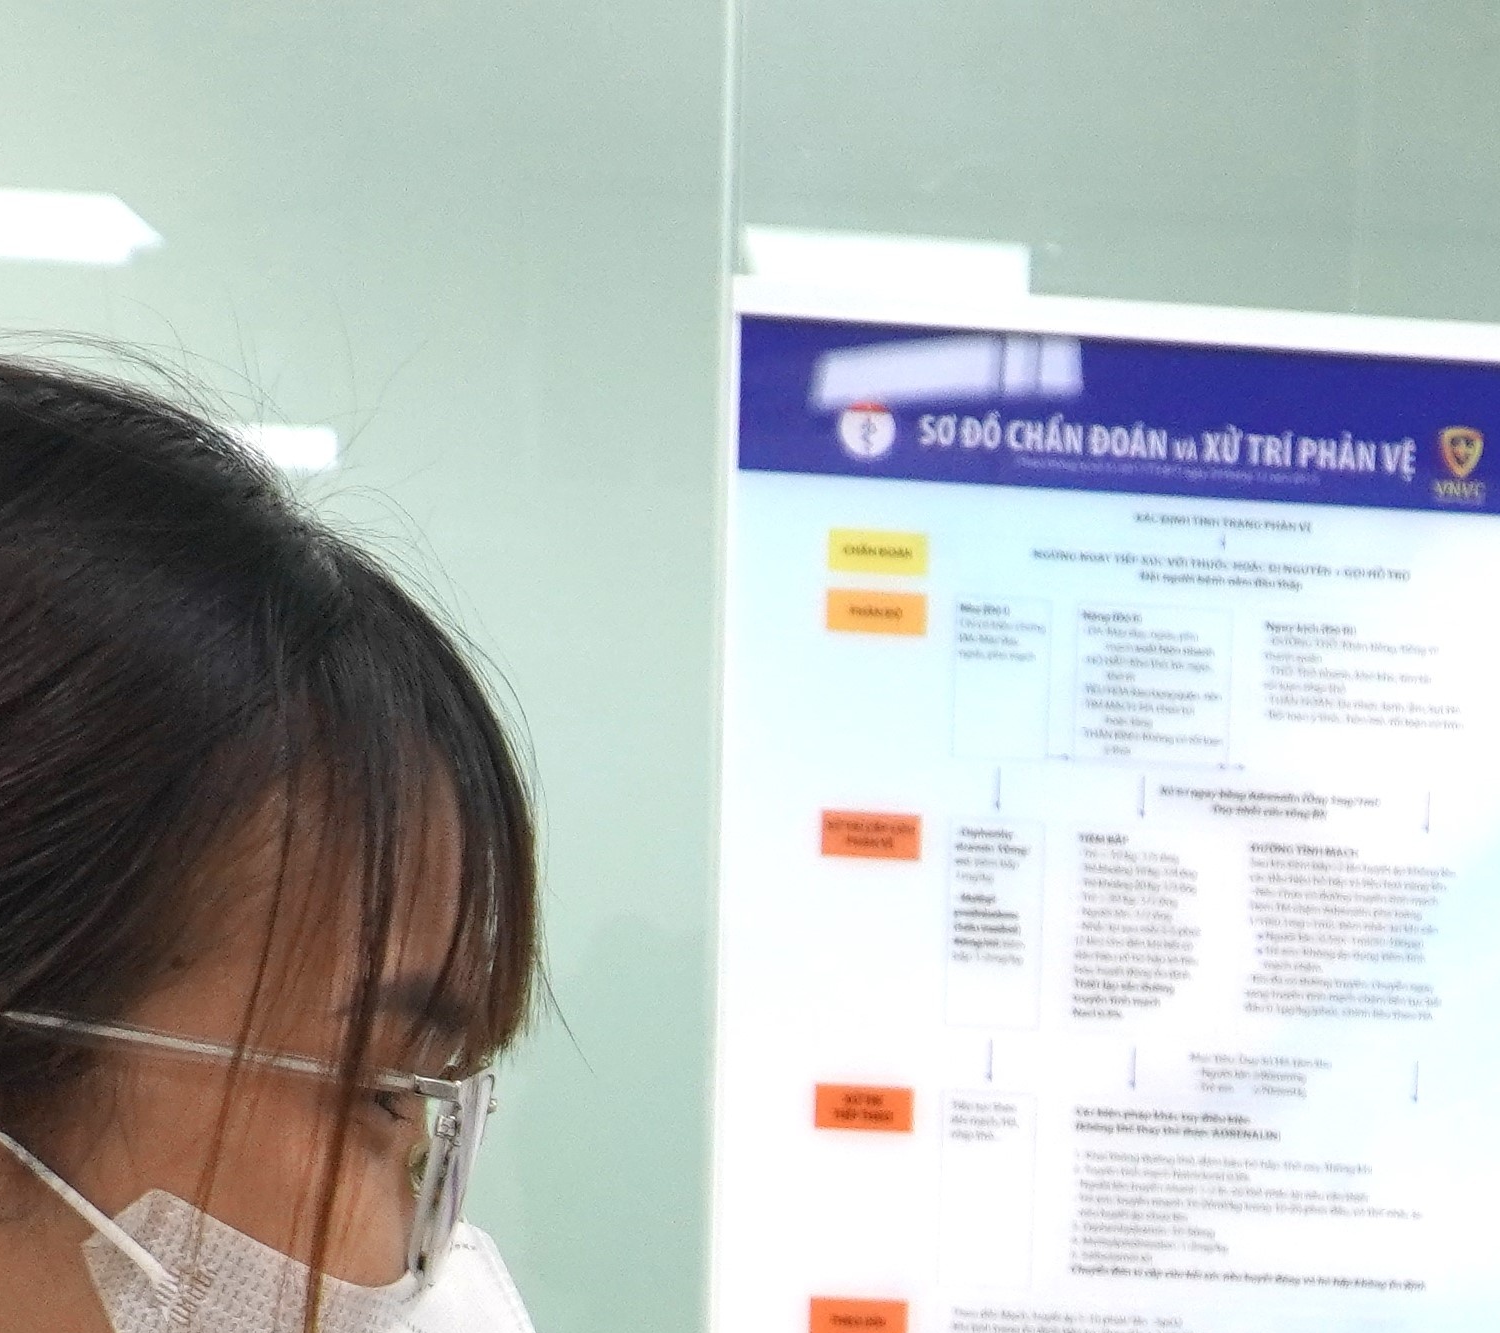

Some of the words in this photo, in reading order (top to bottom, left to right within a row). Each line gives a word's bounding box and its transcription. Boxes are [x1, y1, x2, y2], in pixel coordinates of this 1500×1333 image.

[920, 411, 957, 447] SƠ
[959, 407, 1001, 450] ĐỒ
[1005, 408, 1083, 455] CHẨN
[1086, 416, 1168, 460] ĐOÁN
[1200, 420, 1243, 465] XỬ
[1247, 426, 1293, 468] TRÍ
[1296, 426, 1376, 473] PHẢN
[1380, 433, 1416, 483] VỆ
[1435, 479, 1484, 503] VNVC
